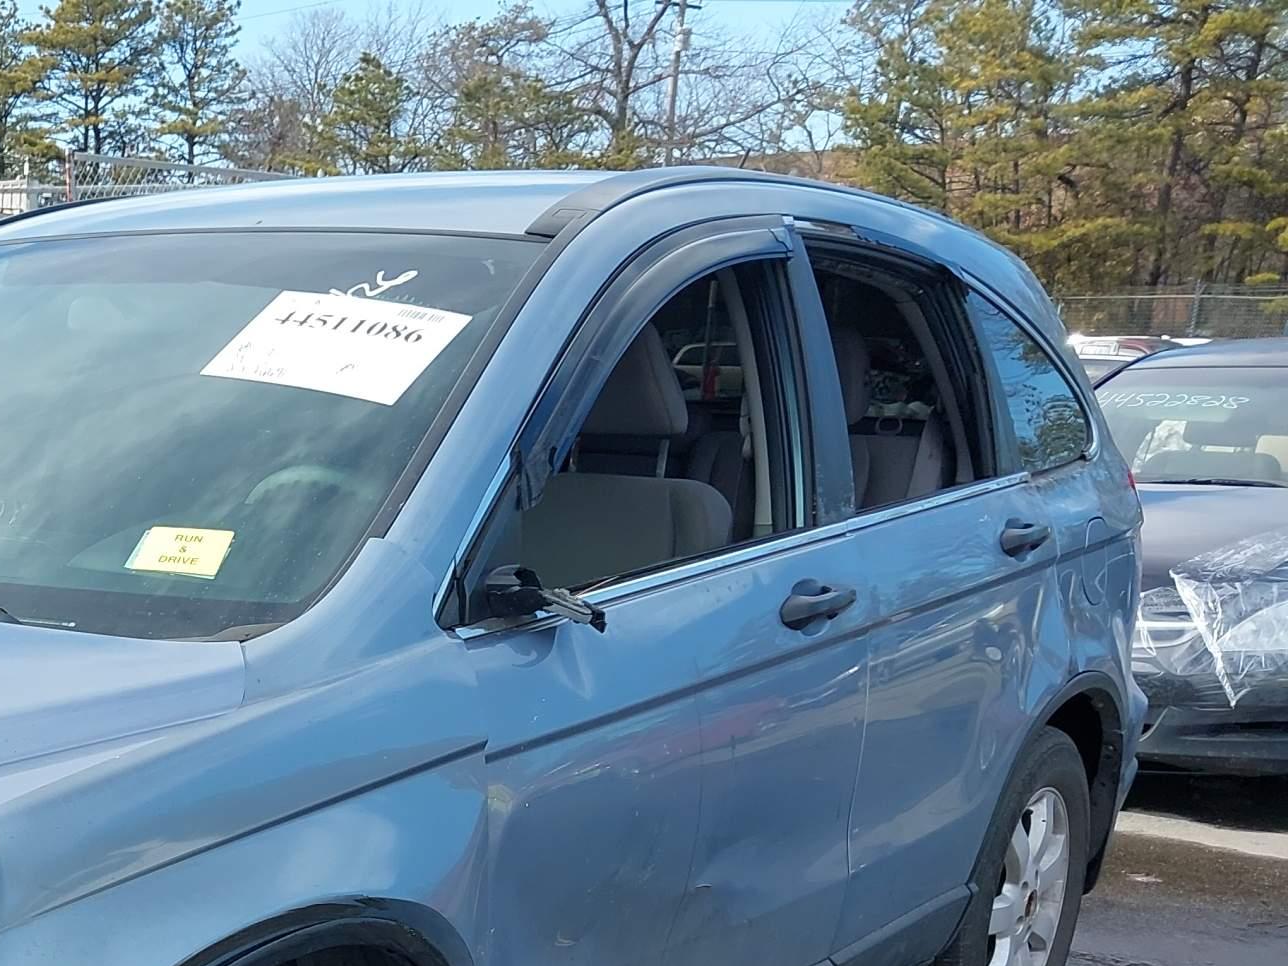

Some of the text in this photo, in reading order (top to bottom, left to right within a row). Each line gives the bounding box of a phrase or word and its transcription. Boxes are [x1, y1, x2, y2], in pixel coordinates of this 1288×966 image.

[275, 311, 424, 343] 44511086
[175, 534, 203, 543] RUN
[159, 555, 200, 565] DRIVE
